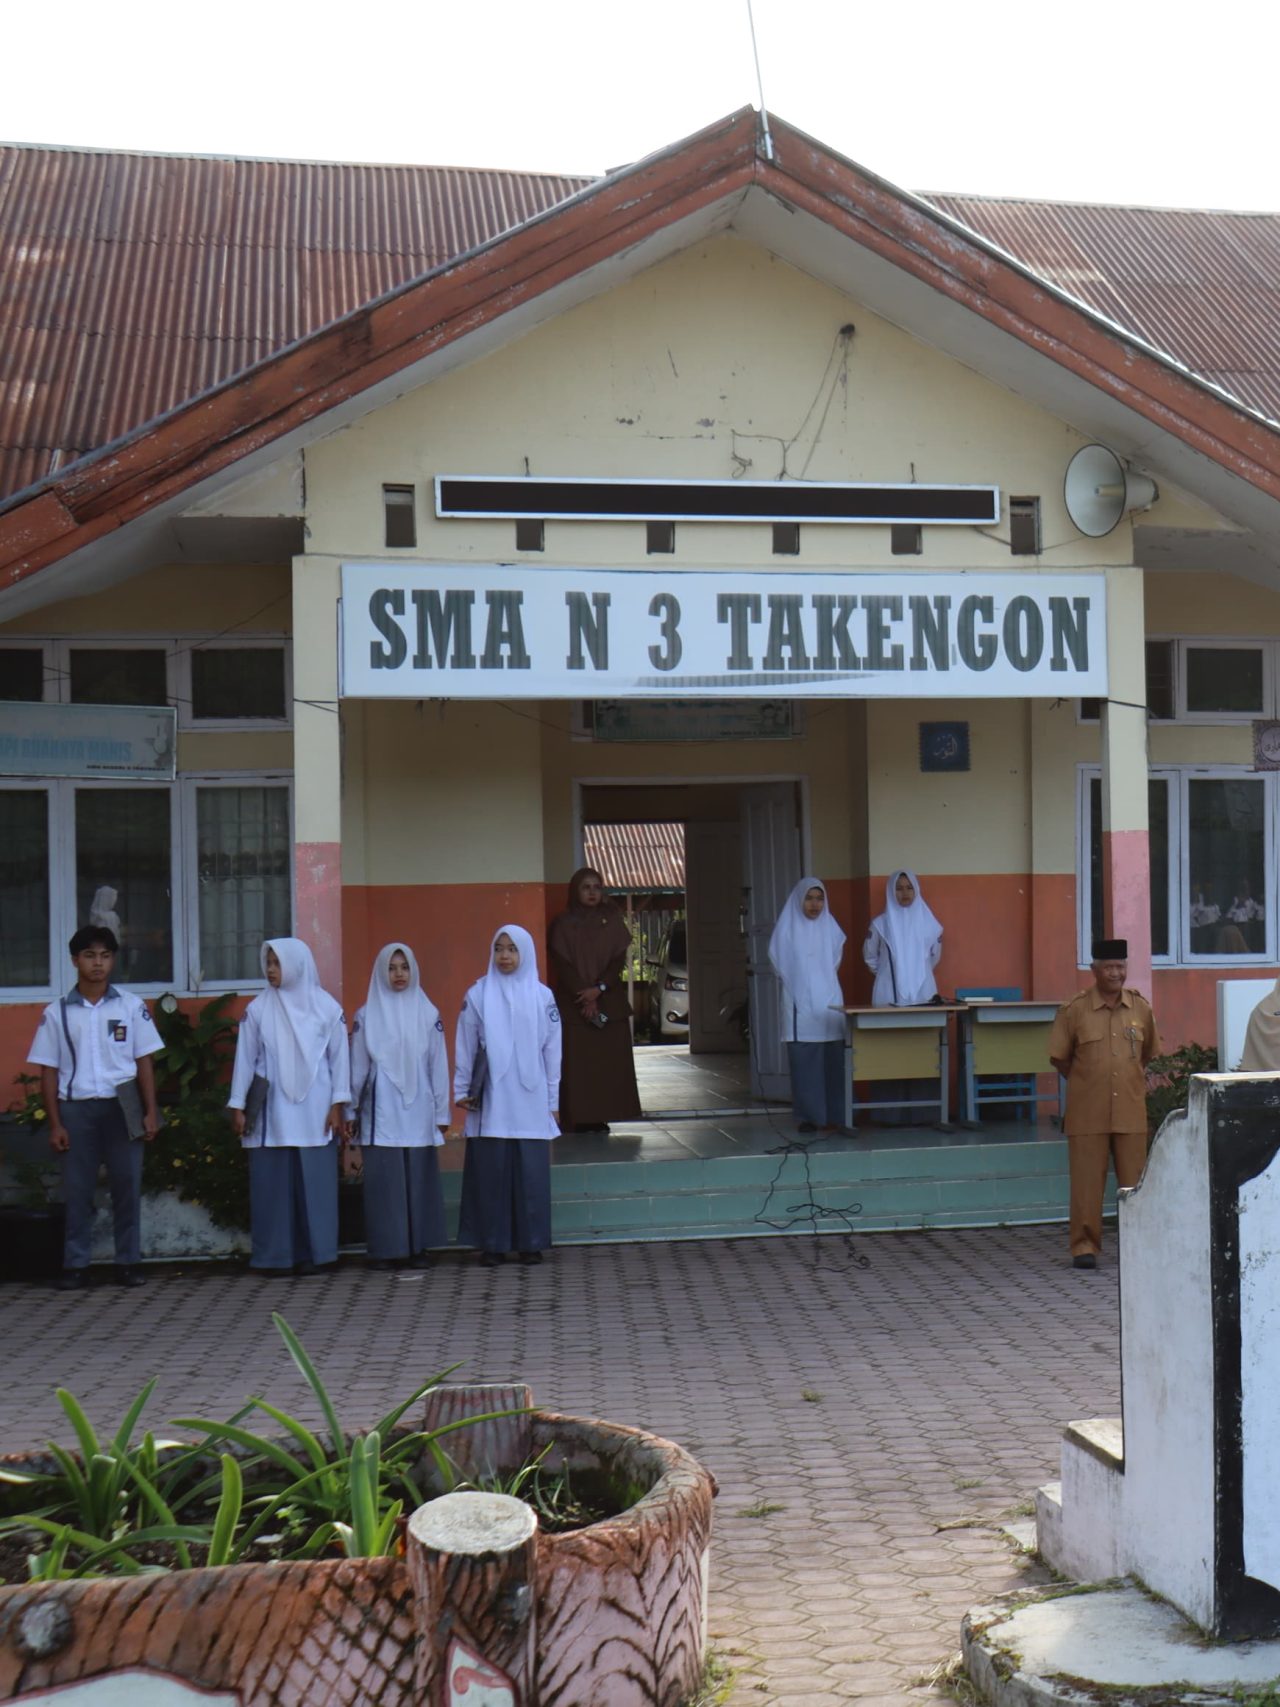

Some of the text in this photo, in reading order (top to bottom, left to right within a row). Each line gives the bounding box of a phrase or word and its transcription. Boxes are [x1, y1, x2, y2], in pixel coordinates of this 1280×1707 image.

[369, 588, 1090, 672] SMA N 3 TAKENGON
